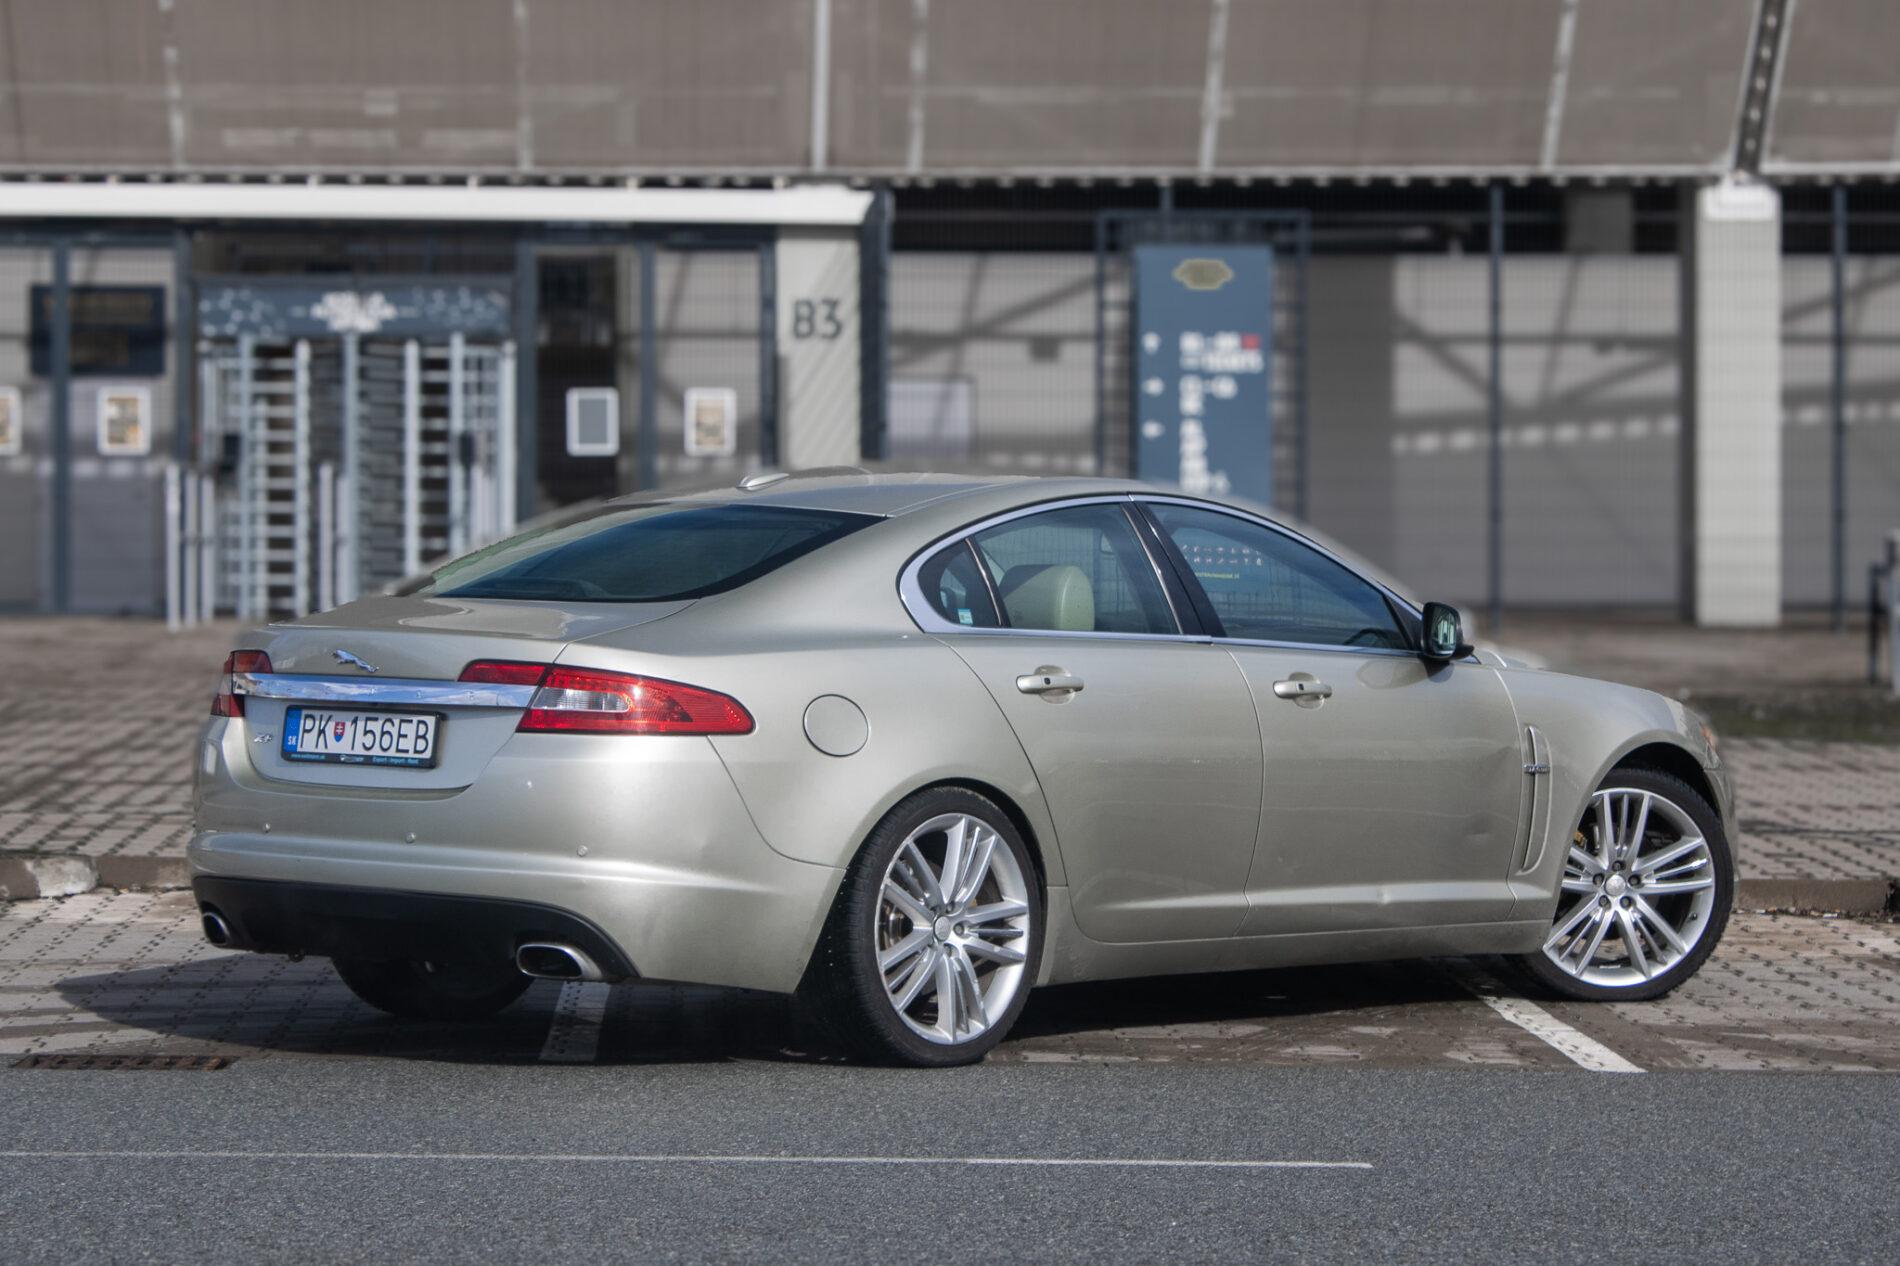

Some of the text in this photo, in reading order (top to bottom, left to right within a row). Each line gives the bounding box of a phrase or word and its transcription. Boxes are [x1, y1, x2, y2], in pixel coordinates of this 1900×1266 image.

[793, 298, 843, 340] B3
[287, 735, 297, 746] SK
[300, 714, 429, 754] PK 156EB
